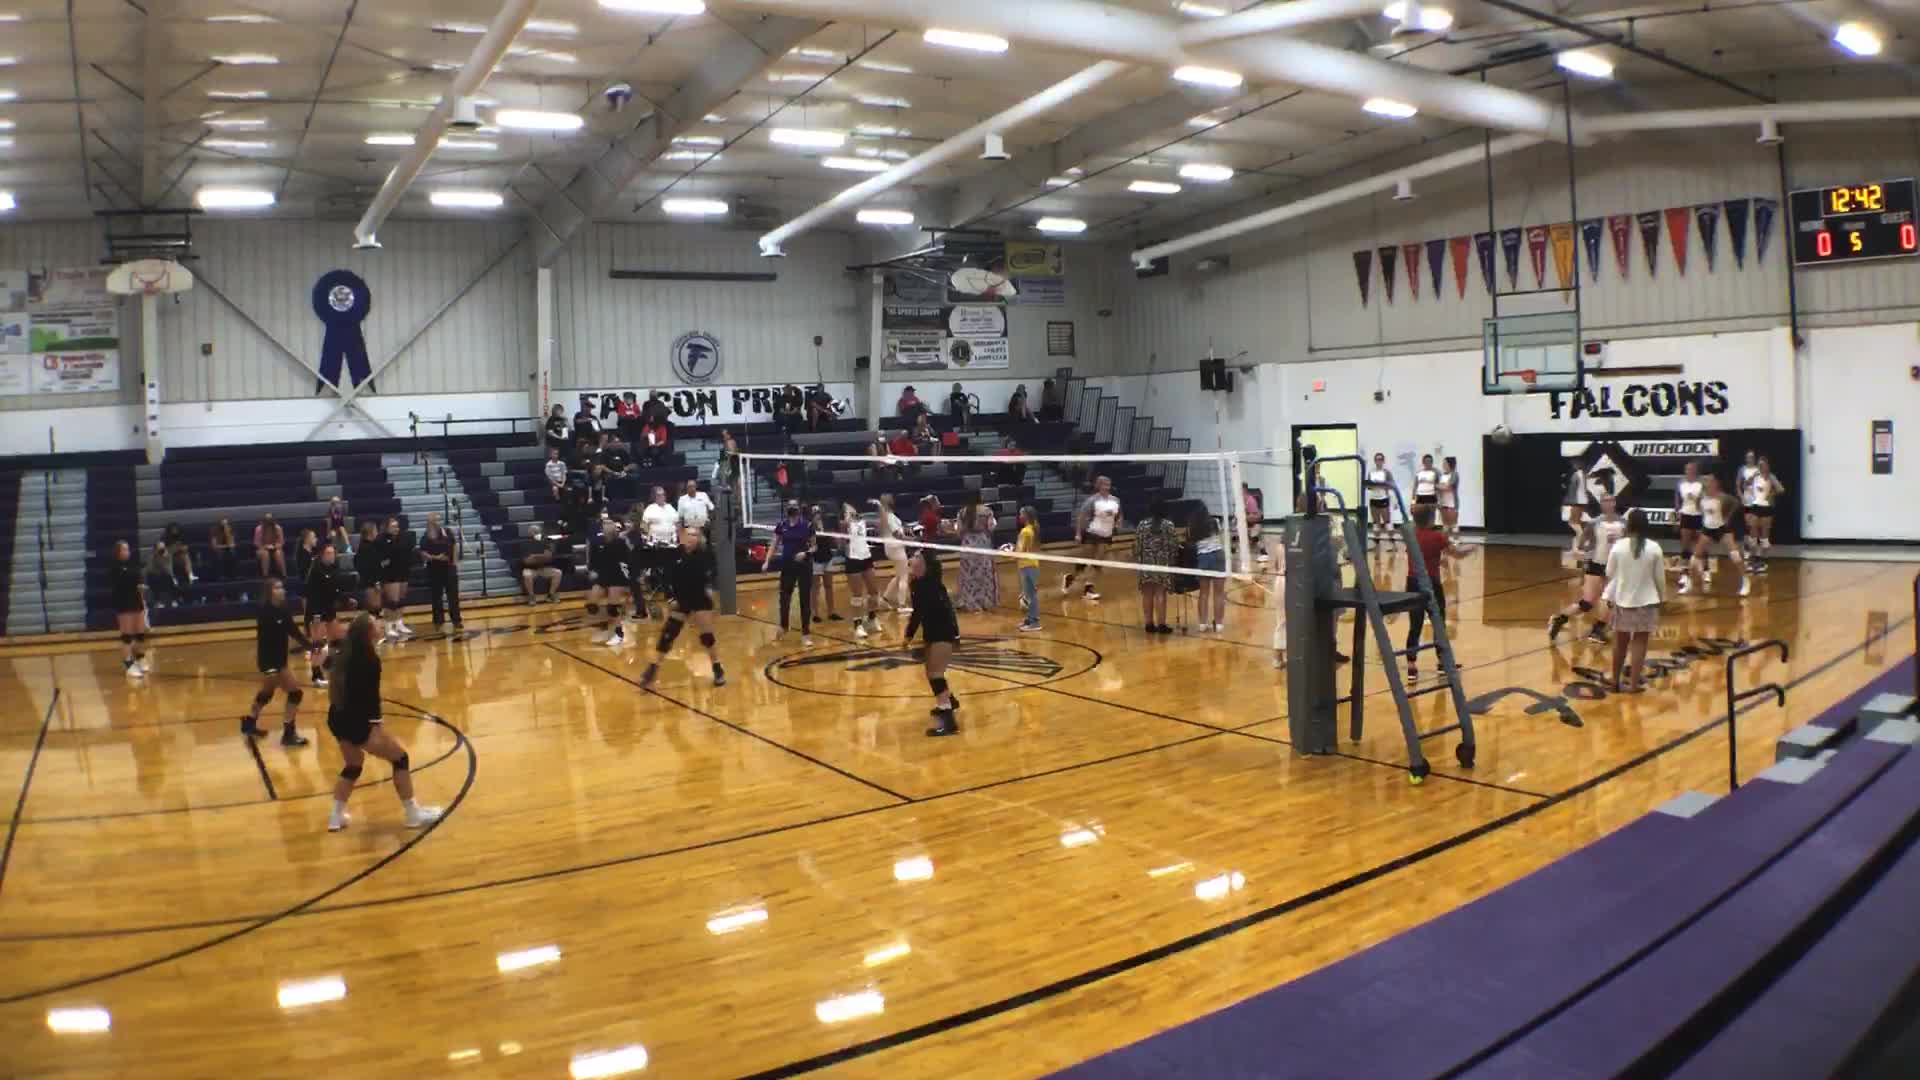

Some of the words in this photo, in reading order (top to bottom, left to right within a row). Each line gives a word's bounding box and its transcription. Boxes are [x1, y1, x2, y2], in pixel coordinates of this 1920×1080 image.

[1831, 184, 1881, 212] 12:42
[1816, 231, 1832, 256] 0
[1850, 231, 1862, 251] 5
[1900, 223, 1915, 249] 0
[579, 387, 720, 419] FACON
[1550, 380, 1729, 419] FALCONS
